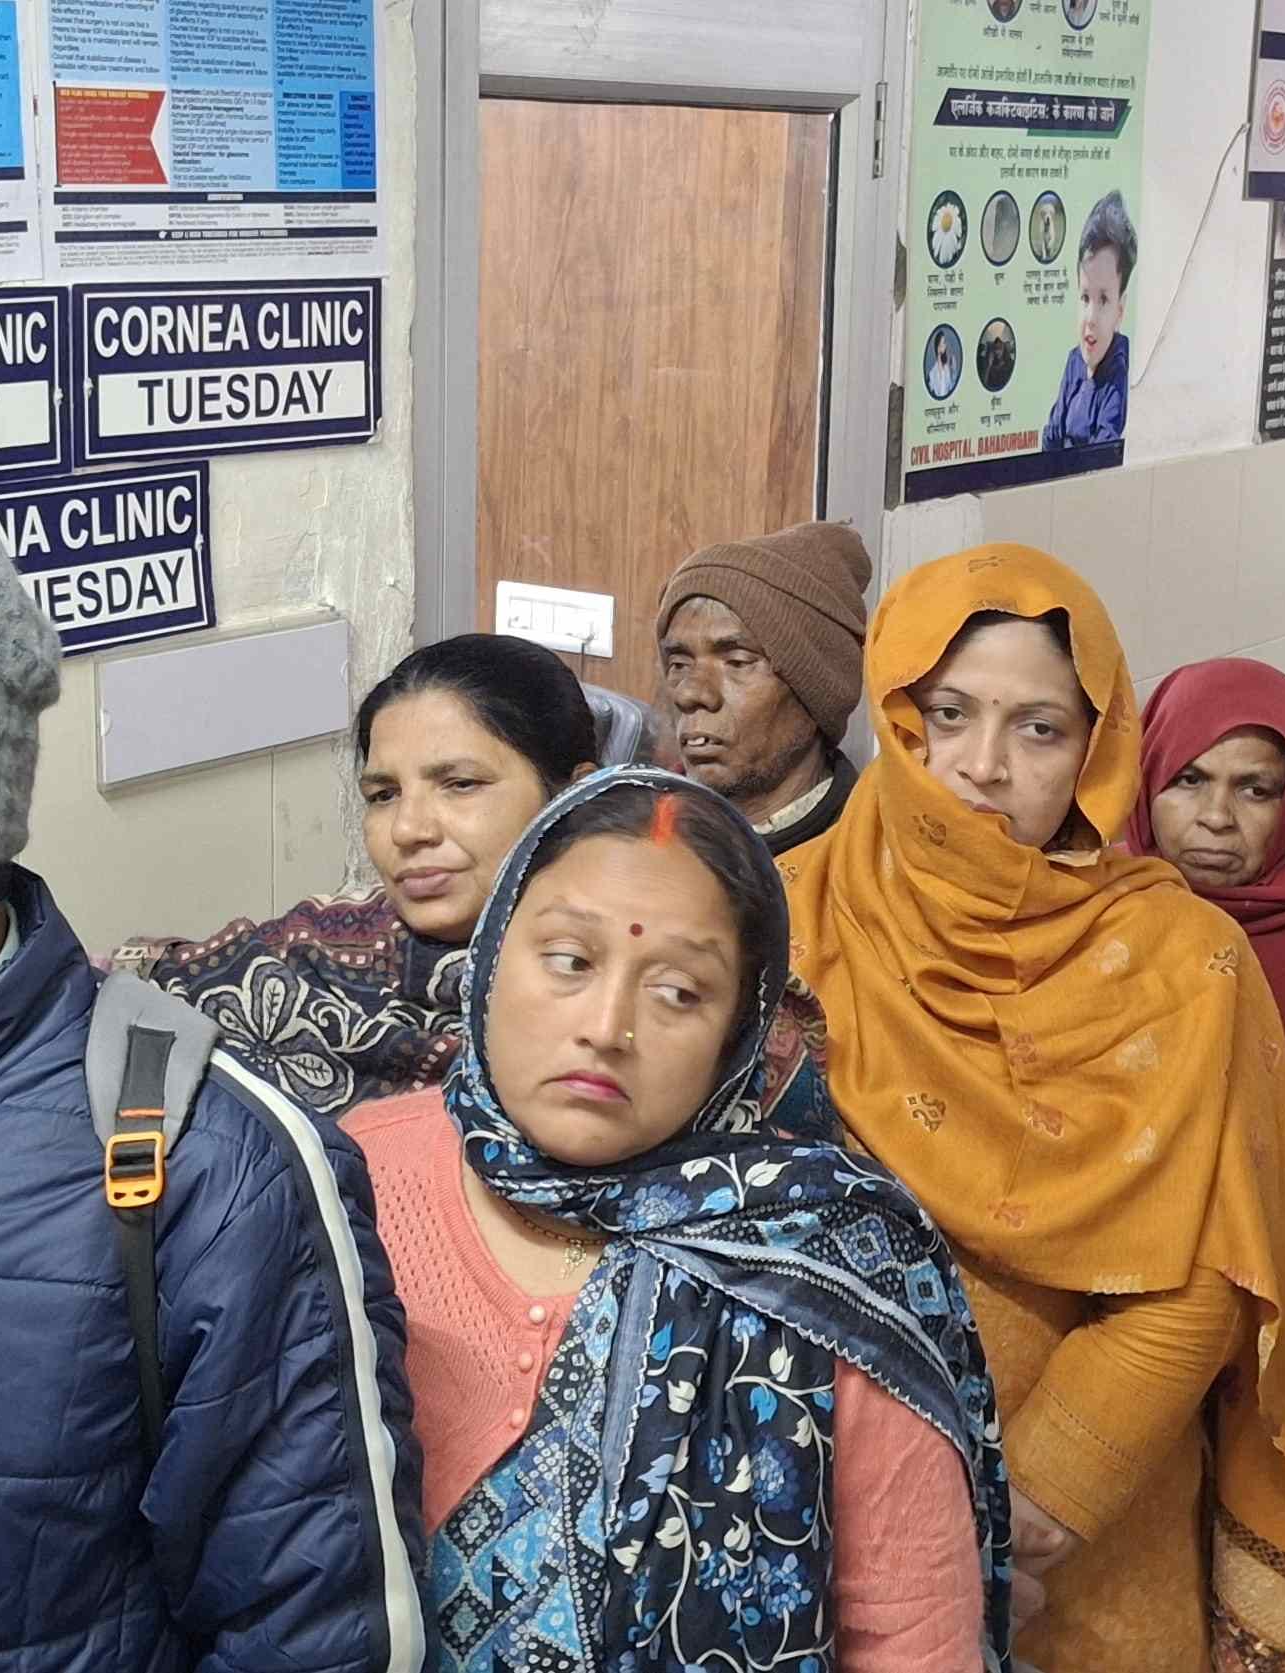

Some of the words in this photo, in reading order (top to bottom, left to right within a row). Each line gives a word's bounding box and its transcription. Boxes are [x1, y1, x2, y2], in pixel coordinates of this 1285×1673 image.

[93, 303, 250, 360] CORNEA
[257, 299, 365, 350] CLINIC
[138, 369, 334, 427] TUESDAY
[911, 445, 930, 466] CIVIL
[60, 485, 192, 550] CLINIC
